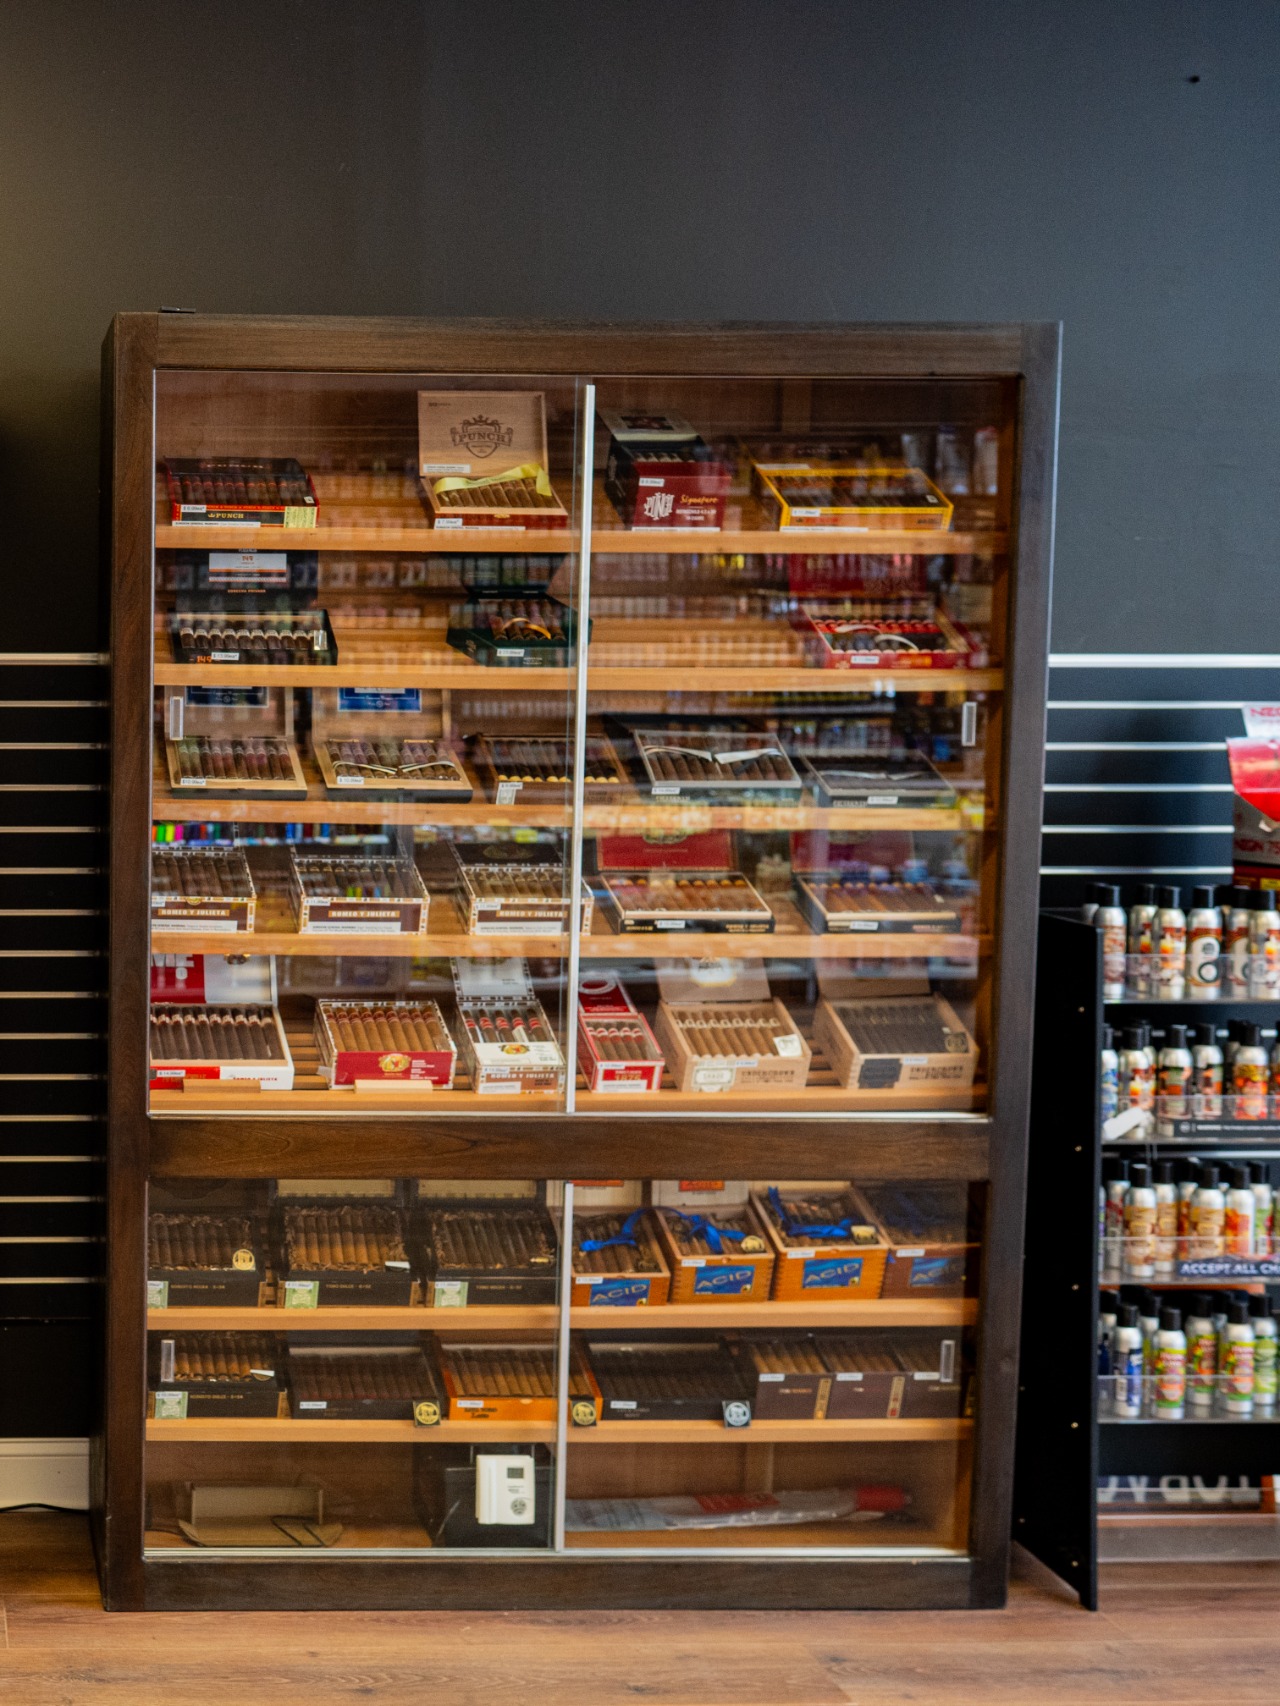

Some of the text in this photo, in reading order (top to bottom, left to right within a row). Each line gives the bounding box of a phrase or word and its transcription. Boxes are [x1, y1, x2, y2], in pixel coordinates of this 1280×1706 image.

[459, 431, 506, 443] PUNCH
[215, 512, 244, 520] PUNCH
[805, 1263, 860, 1284] ACID
[1180, 1263, 1280, 1274] ACCEPT ALL CH
[697, 1270, 753, 1290] ACID
[592, 1284, 648, 1303] ACID
